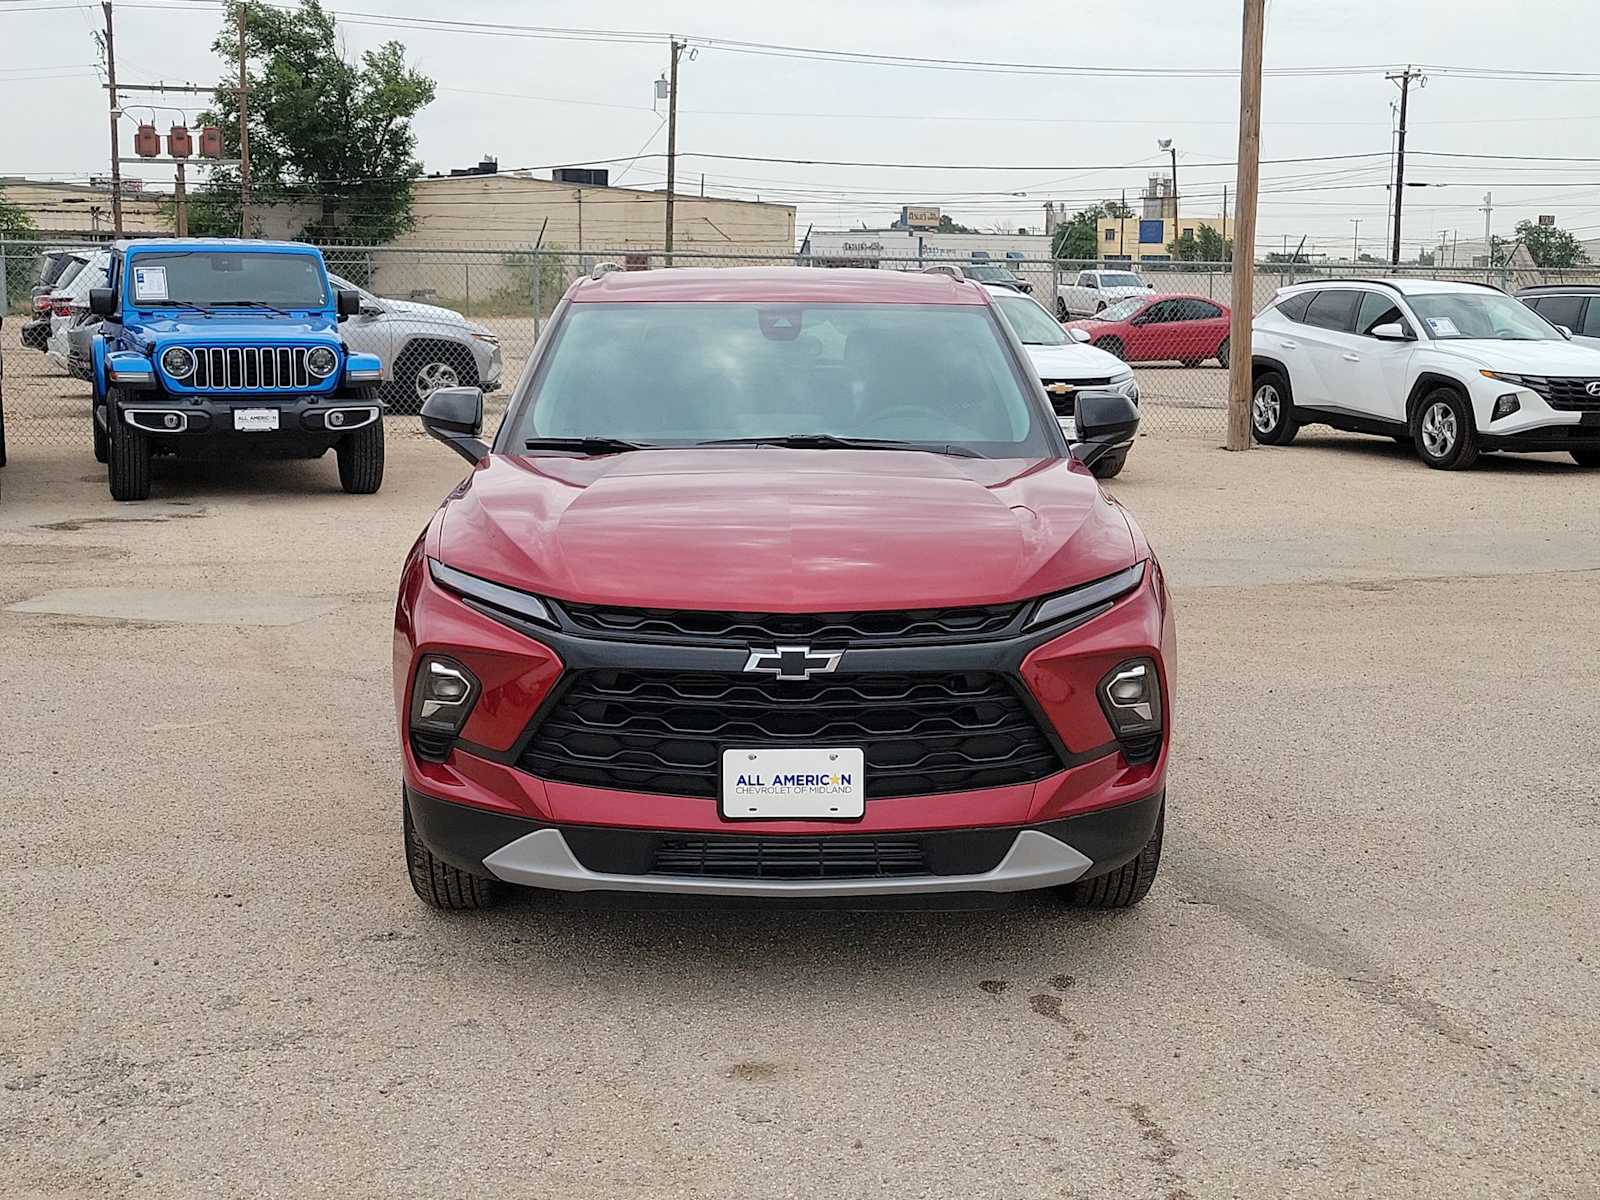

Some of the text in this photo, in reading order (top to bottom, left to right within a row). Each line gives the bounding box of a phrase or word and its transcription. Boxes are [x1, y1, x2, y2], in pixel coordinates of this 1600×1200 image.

[736, 774, 852, 786] ALL AMERICN
[735, 786, 853, 794] CHEVROLET OF MIDLAND
